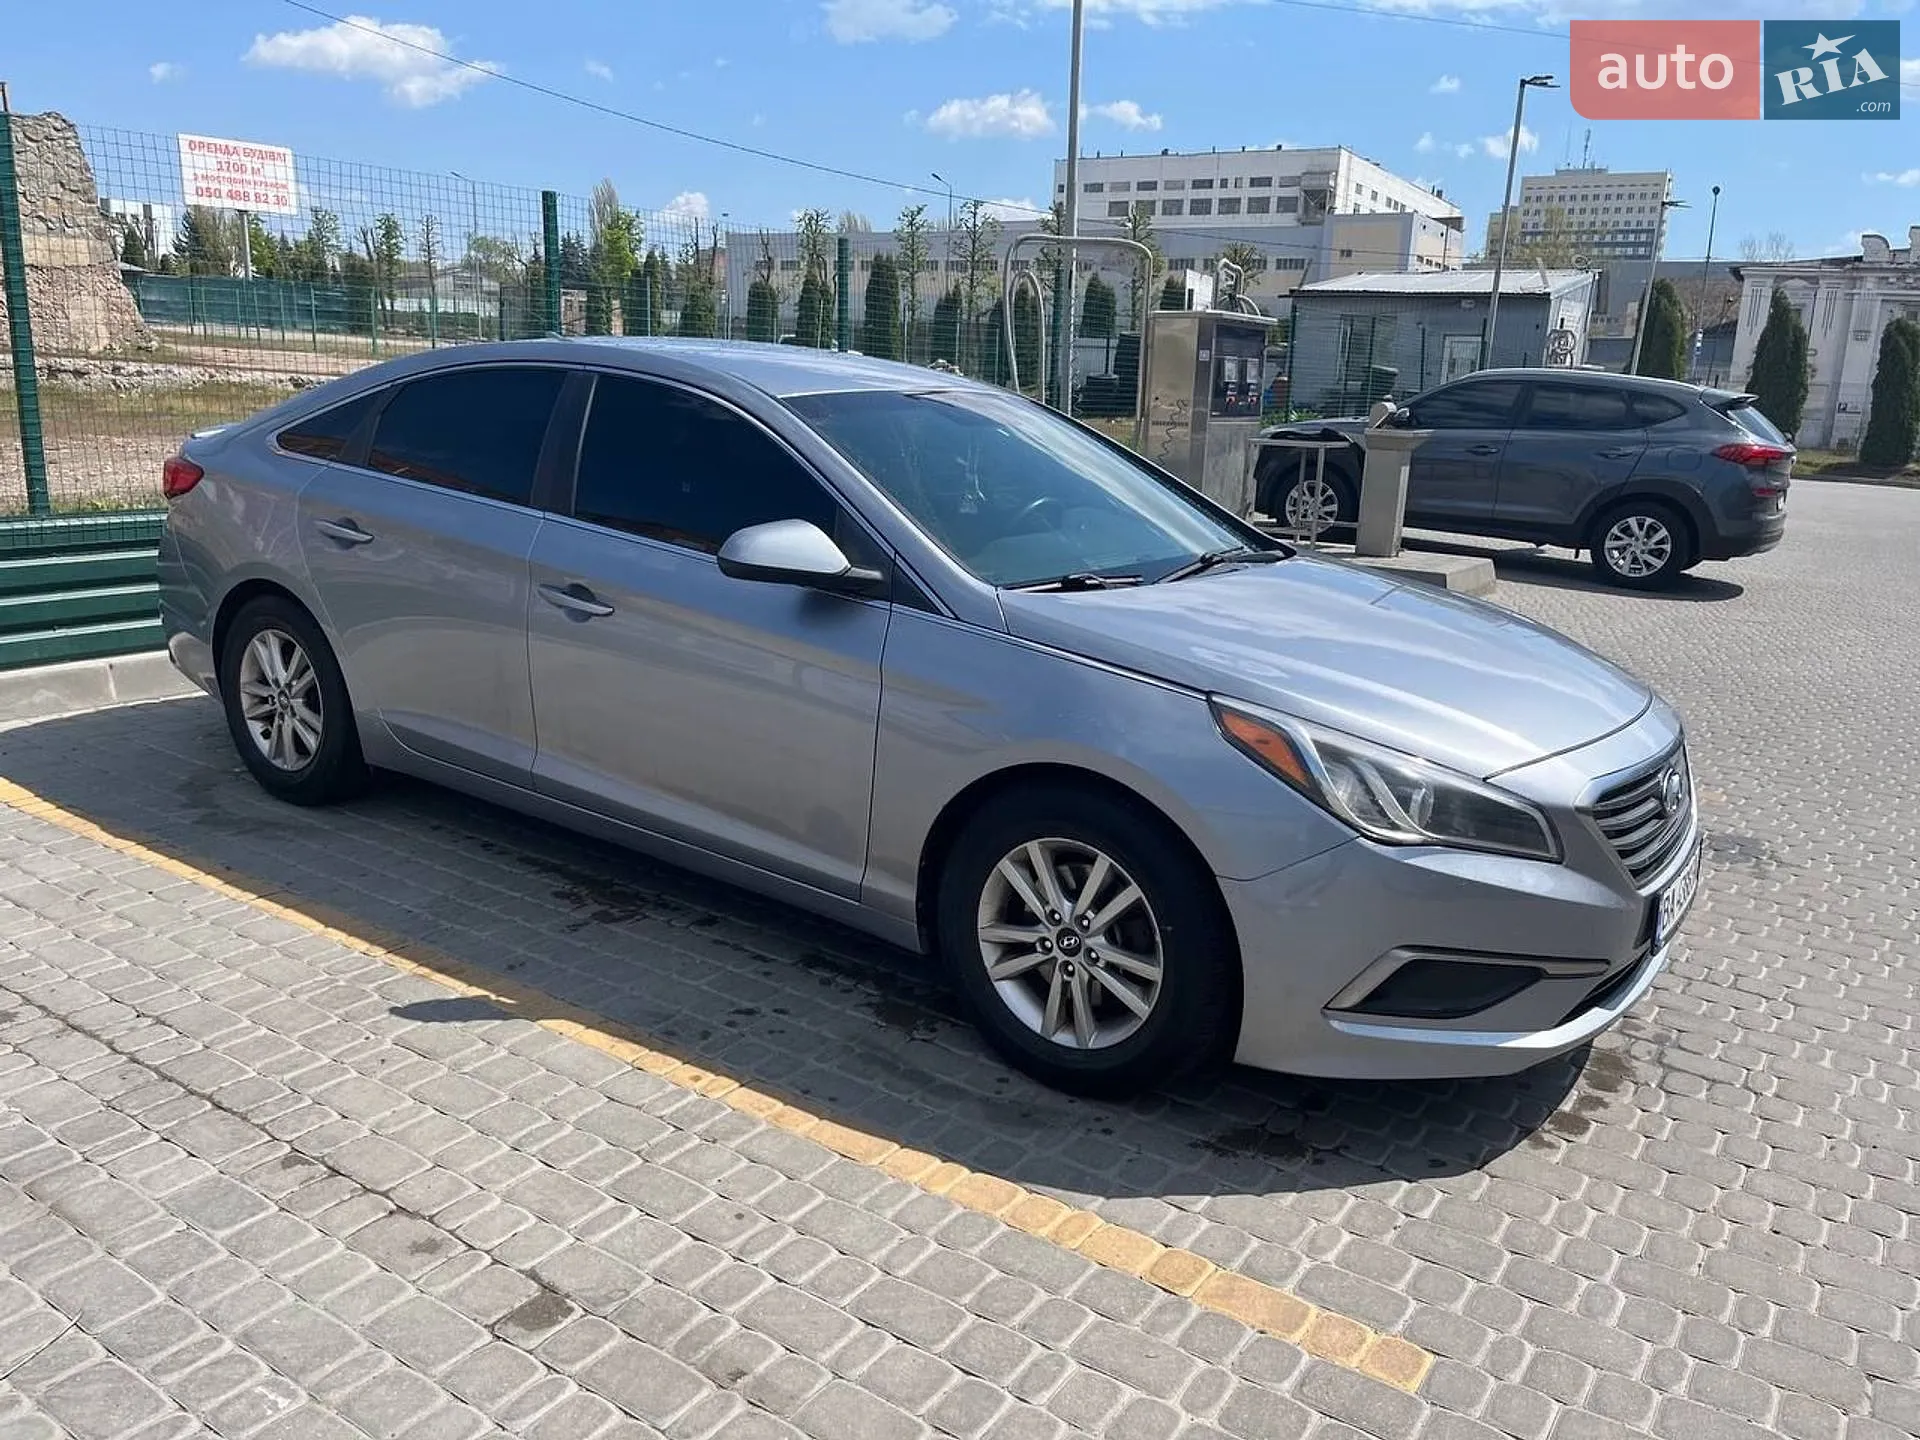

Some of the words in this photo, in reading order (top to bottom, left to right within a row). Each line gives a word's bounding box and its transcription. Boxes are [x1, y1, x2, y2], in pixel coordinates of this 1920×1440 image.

[188, 140, 240, 157] ОРЕНДА
[243, 147, 287, 162] БУДІВЛІ
[196, 186, 222, 199] 050
[254, 192, 270, 204] 82
